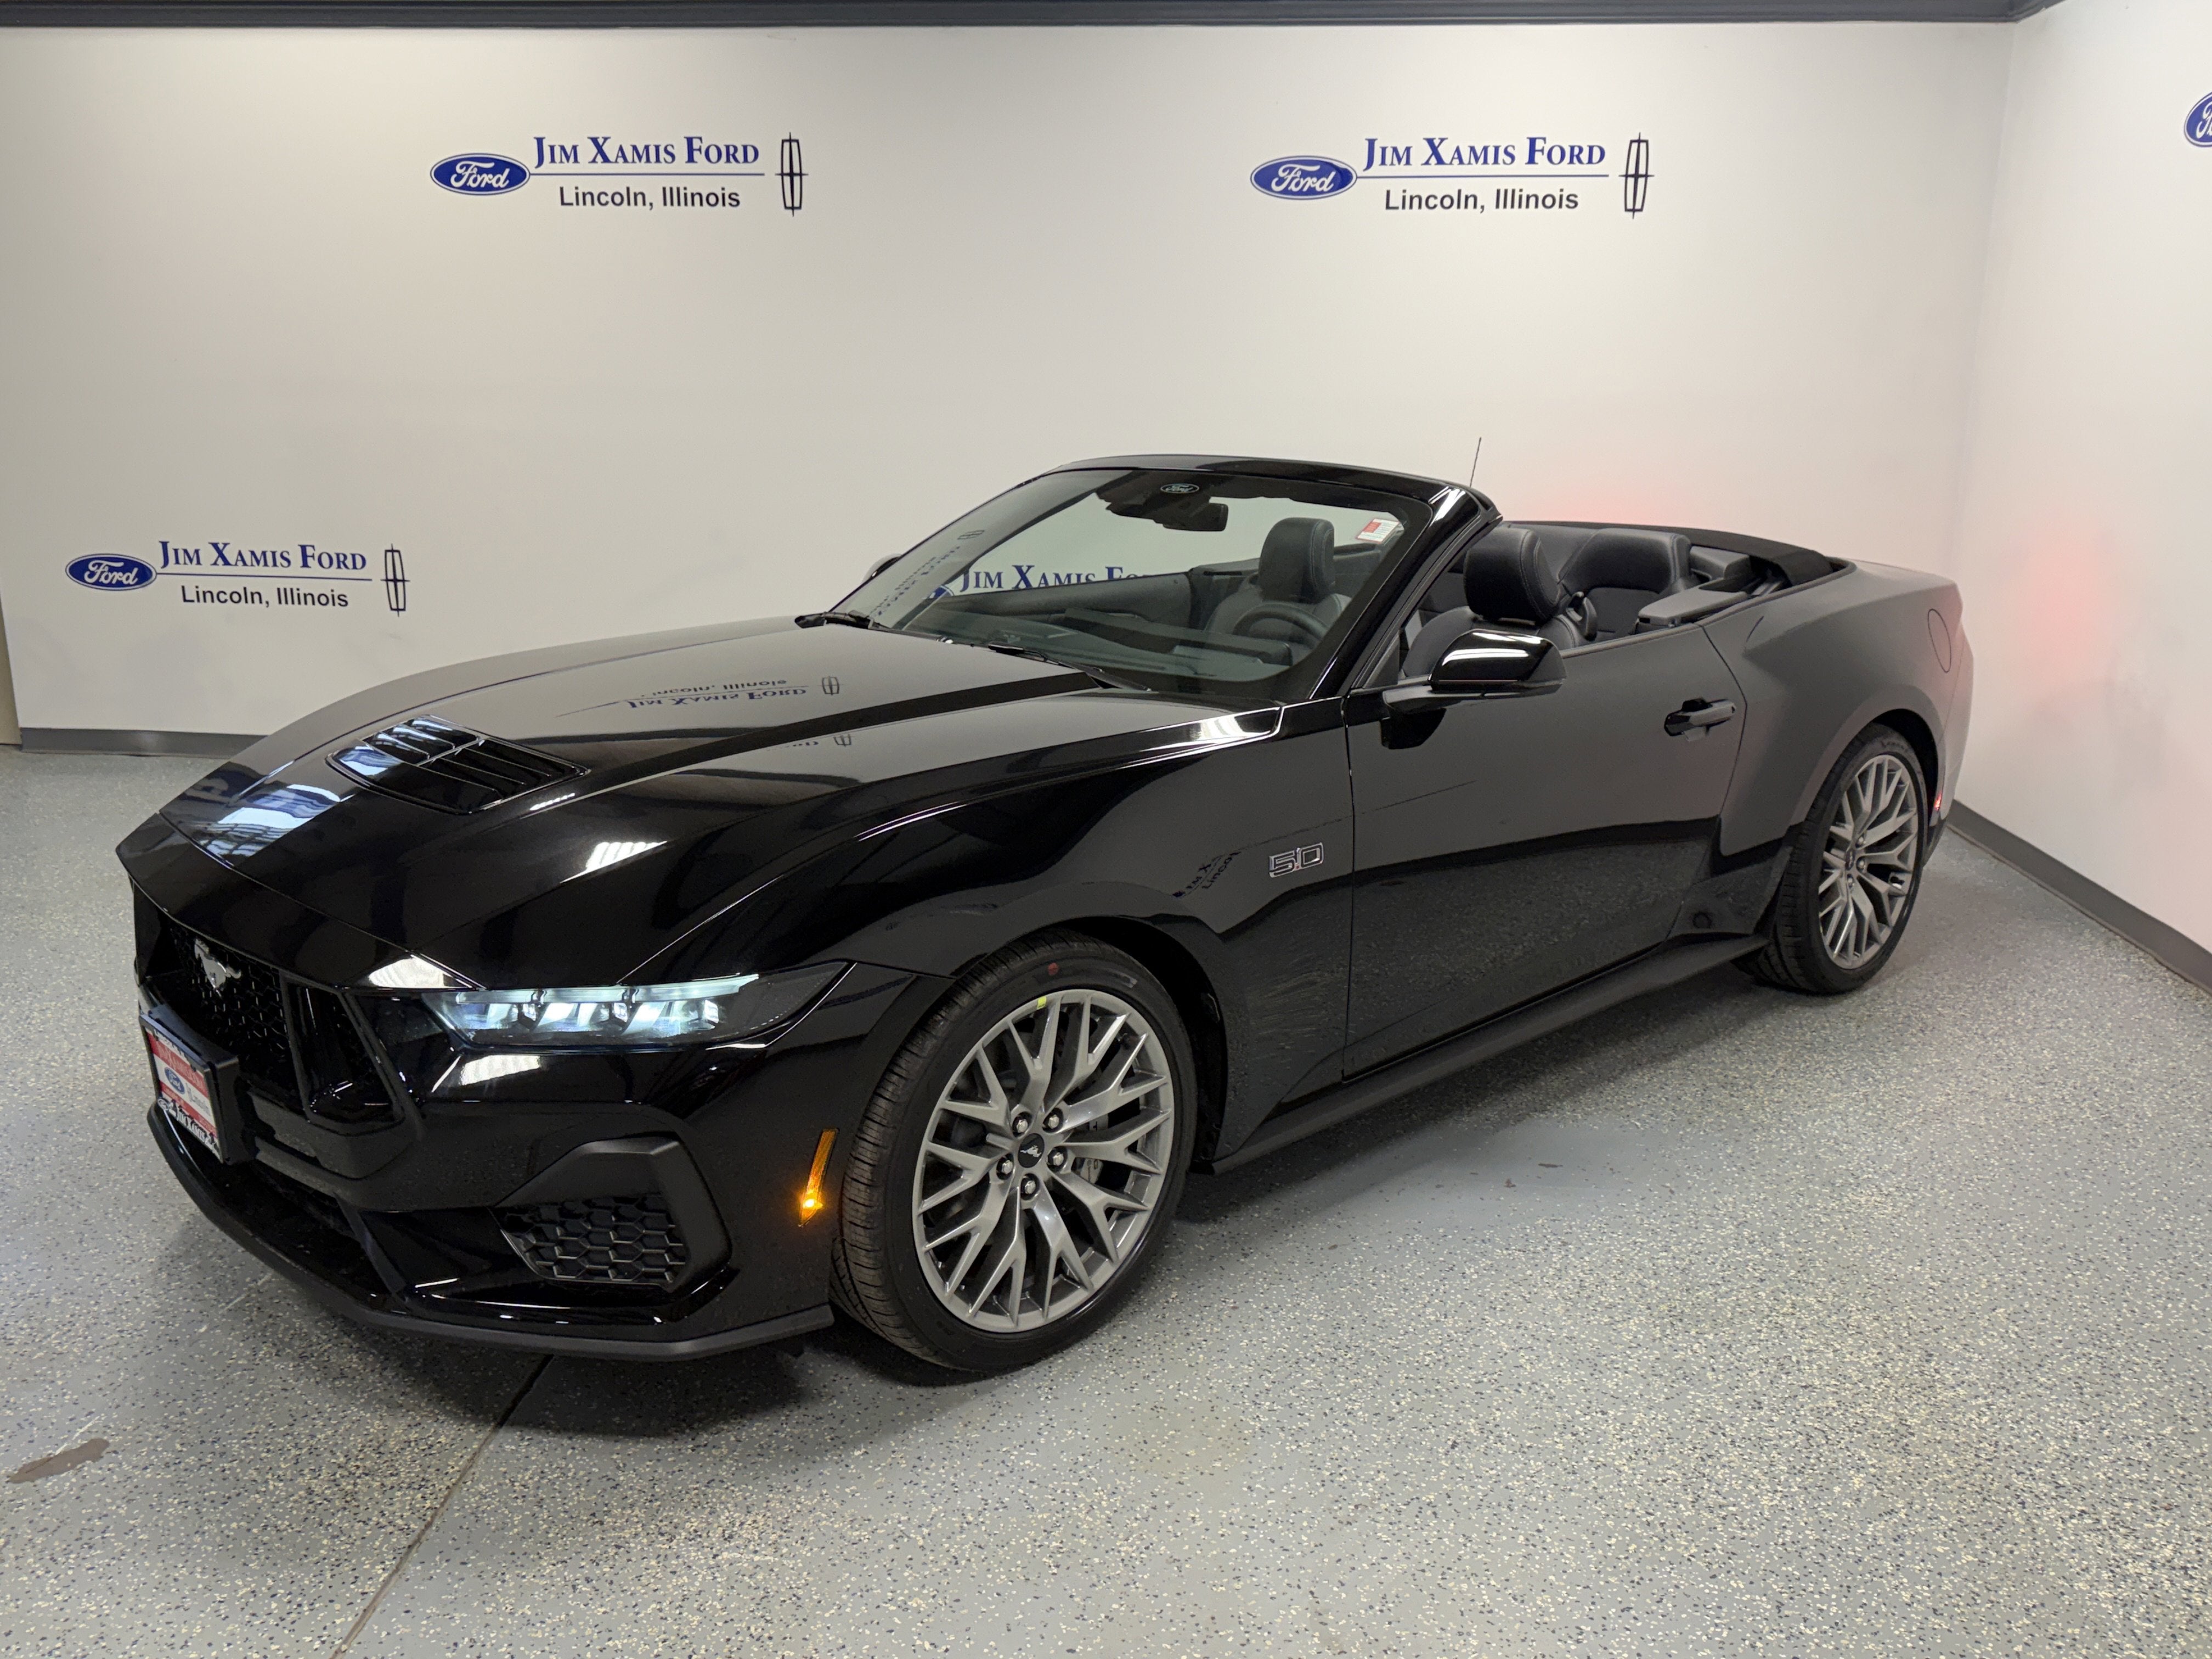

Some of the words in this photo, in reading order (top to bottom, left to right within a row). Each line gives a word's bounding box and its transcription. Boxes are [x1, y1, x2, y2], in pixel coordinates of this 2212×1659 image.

[533, 137, 580, 169] JIM
[587, 137, 676, 164] XAMIS
[684, 136, 759, 164] FORD
[1363, 138, 1413, 172] JIM
[1420, 137, 1516, 166] XAMIS
[1525, 137, 1606, 165] FORD
[450, 161, 510, 188] Ford
[1271, 163, 1336, 192] Ford
[559, 186, 653, 211] Lincoln,
[662, 186, 741, 207] Illinois
[1385, 189, 1485, 214] Lincoln,
[1495, 188, 1579, 210] Illinois
[159, 540, 202, 569] JIM
[210, 542, 291, 568] XAMIS
[298, 544, 366, 570] FORD
[84, 560, 138, 585] Ford
[181, 585, 269, 608] Lincoln,
[276, 584, 349, 607] Illinois
